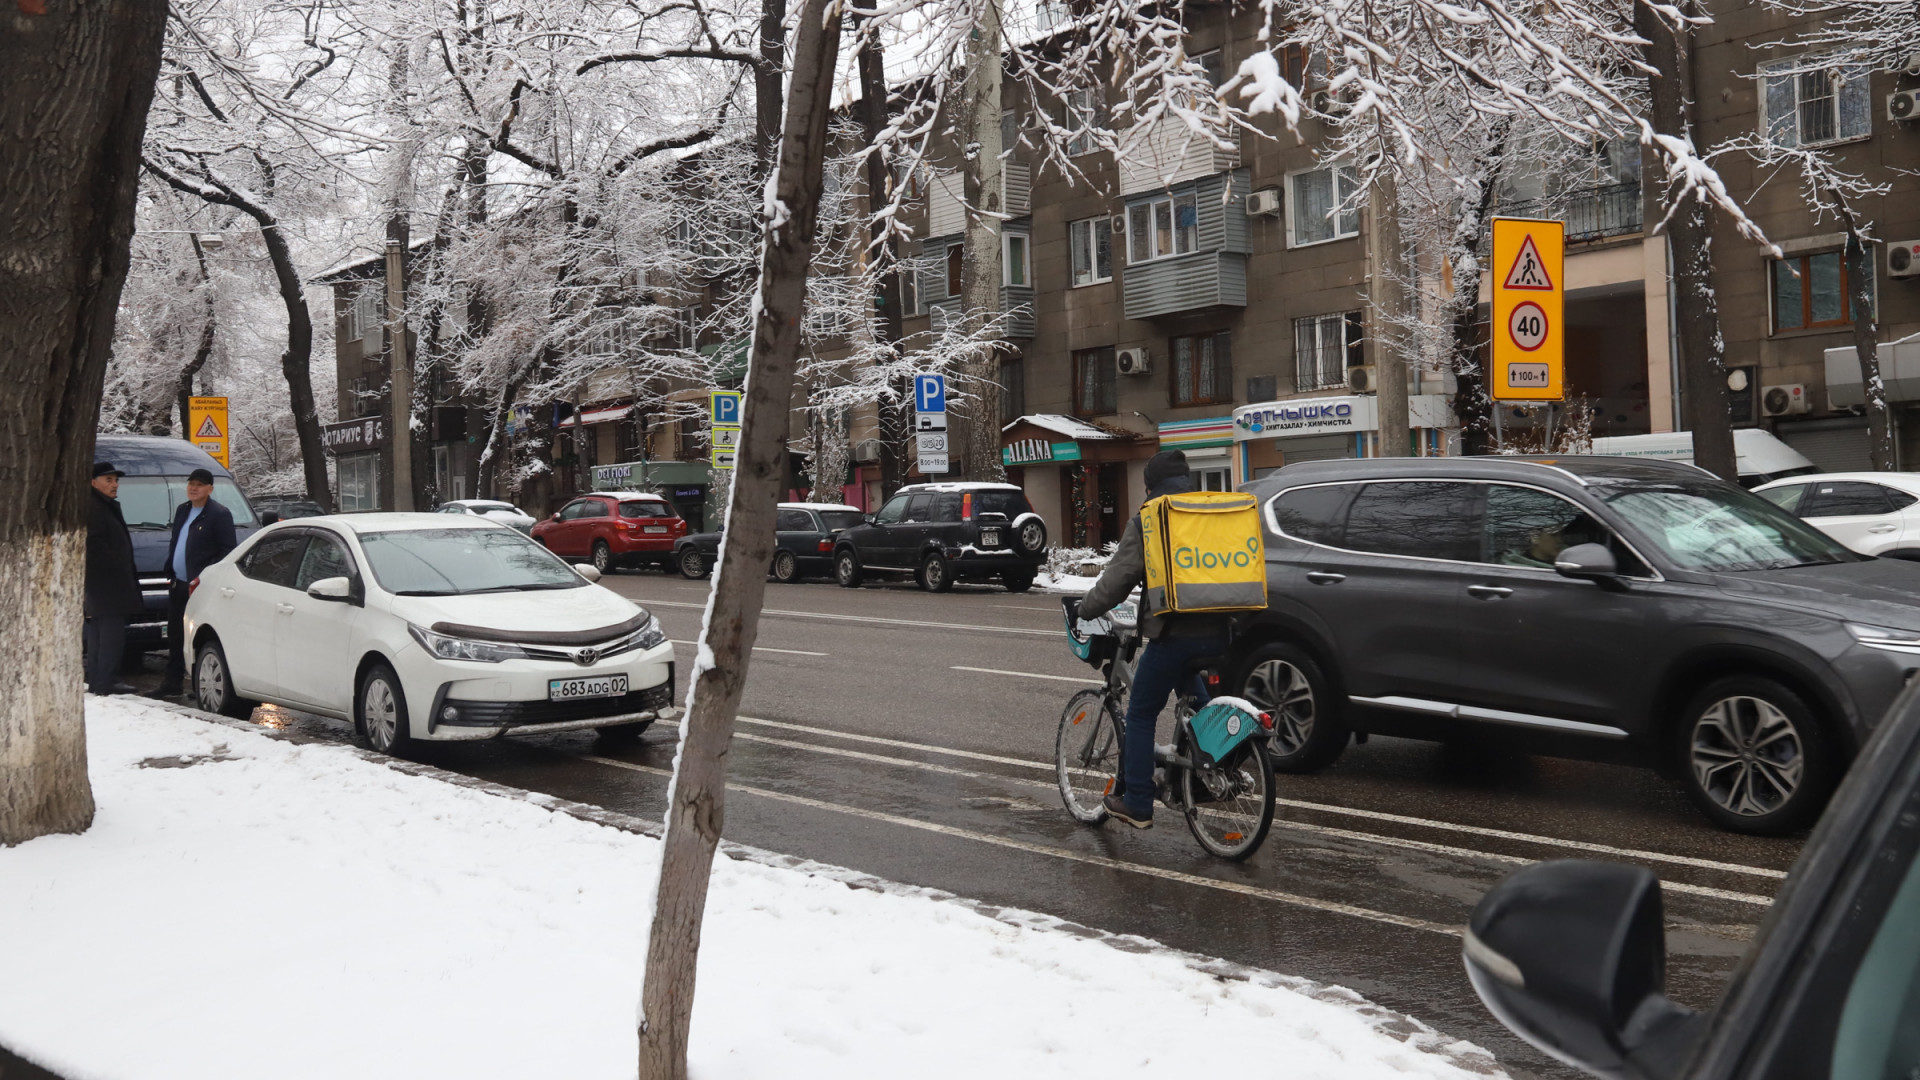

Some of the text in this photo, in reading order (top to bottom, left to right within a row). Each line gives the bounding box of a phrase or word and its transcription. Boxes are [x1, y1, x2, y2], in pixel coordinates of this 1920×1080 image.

[1517, 316, 1540, 337] 40
[1518, 371, 1533, 381] 100
[922, 377, 940, 410] P
[721, 397, 735, 420] P
[1243, 403, 1351, 425] ПЯТНЫШКО
[1265, 418, 1352, 432] ХИМТАЗАЛАУ ХИМЧИСТКА
[321, 426, 361, 447] НОТАРИУС
[1008, 438, 1052, 463] ALLANA
[1174, 546, 1250, 569] Glovo
[611, 678, 626, 693] 02
